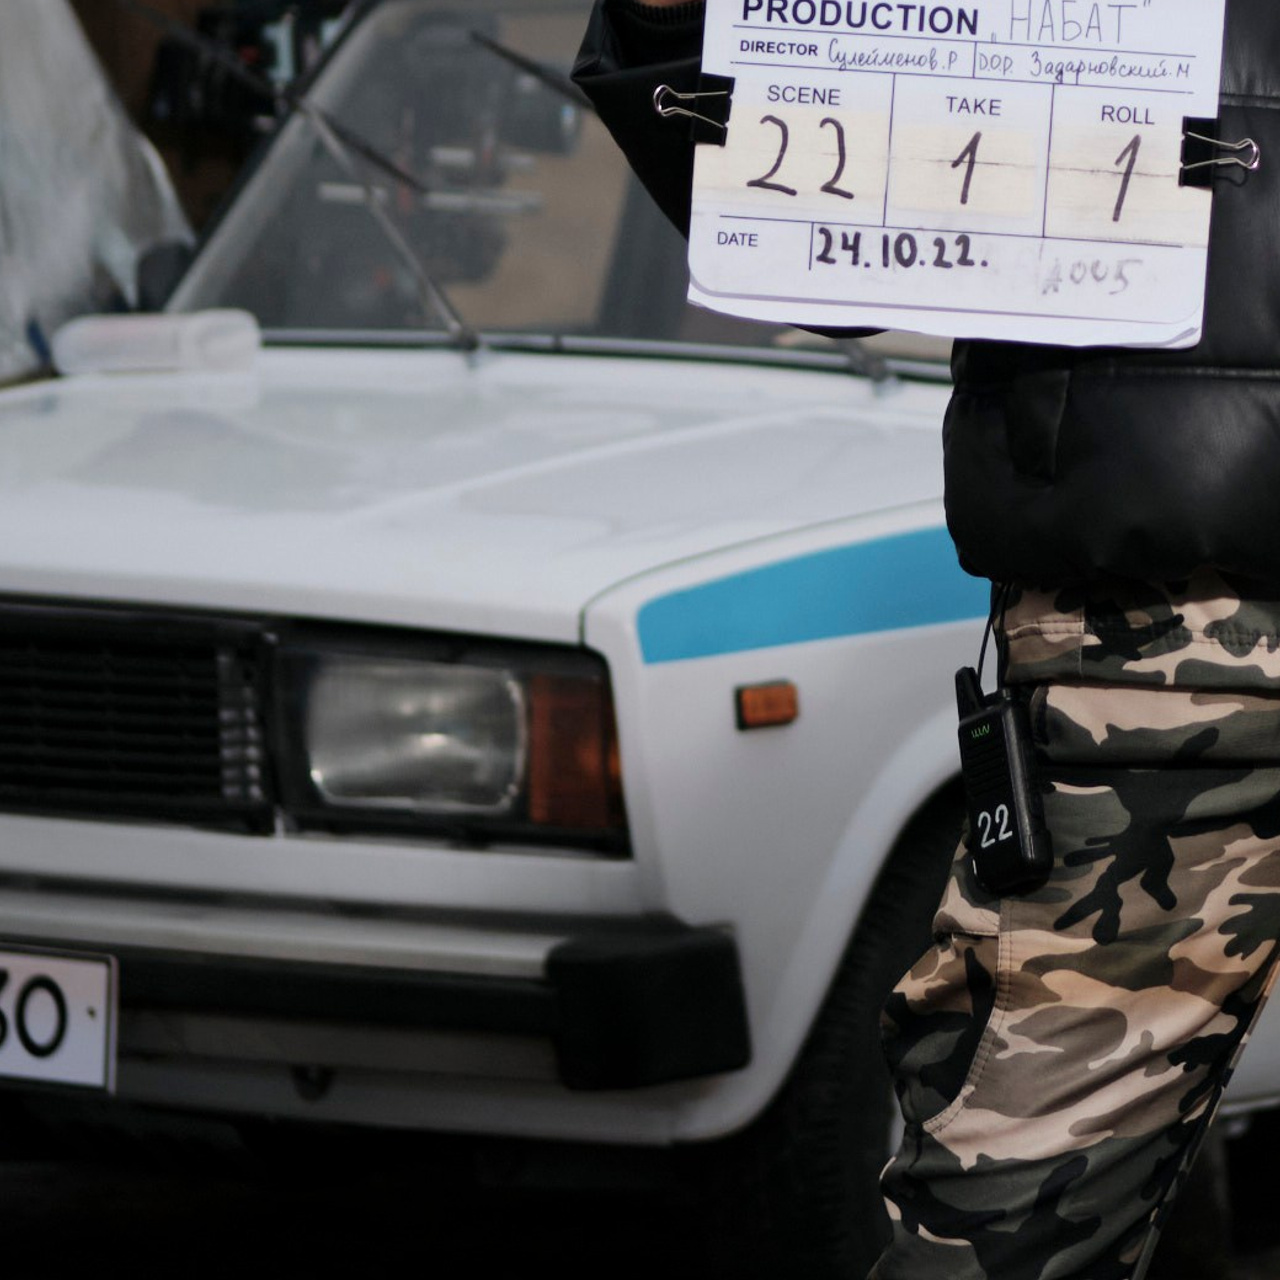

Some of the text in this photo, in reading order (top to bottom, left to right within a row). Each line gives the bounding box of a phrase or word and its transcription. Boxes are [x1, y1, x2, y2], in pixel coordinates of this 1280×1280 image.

[739, 39, 819, 57] DIRECTOR
[766, 84, 841, 106] SCENE
[946, 96, 1002, 116] TAKE
[1101, 105, 1155, 125] ROLL
[746, 114, 855, 200] 22
[950, 131, 982, 205] 1
[1114, 134, 1141, 223] 1
[717, 231, 759, 247] DATE
[977, 803, 1013, 849] 22
[0, 968, 68, 1059] 0
